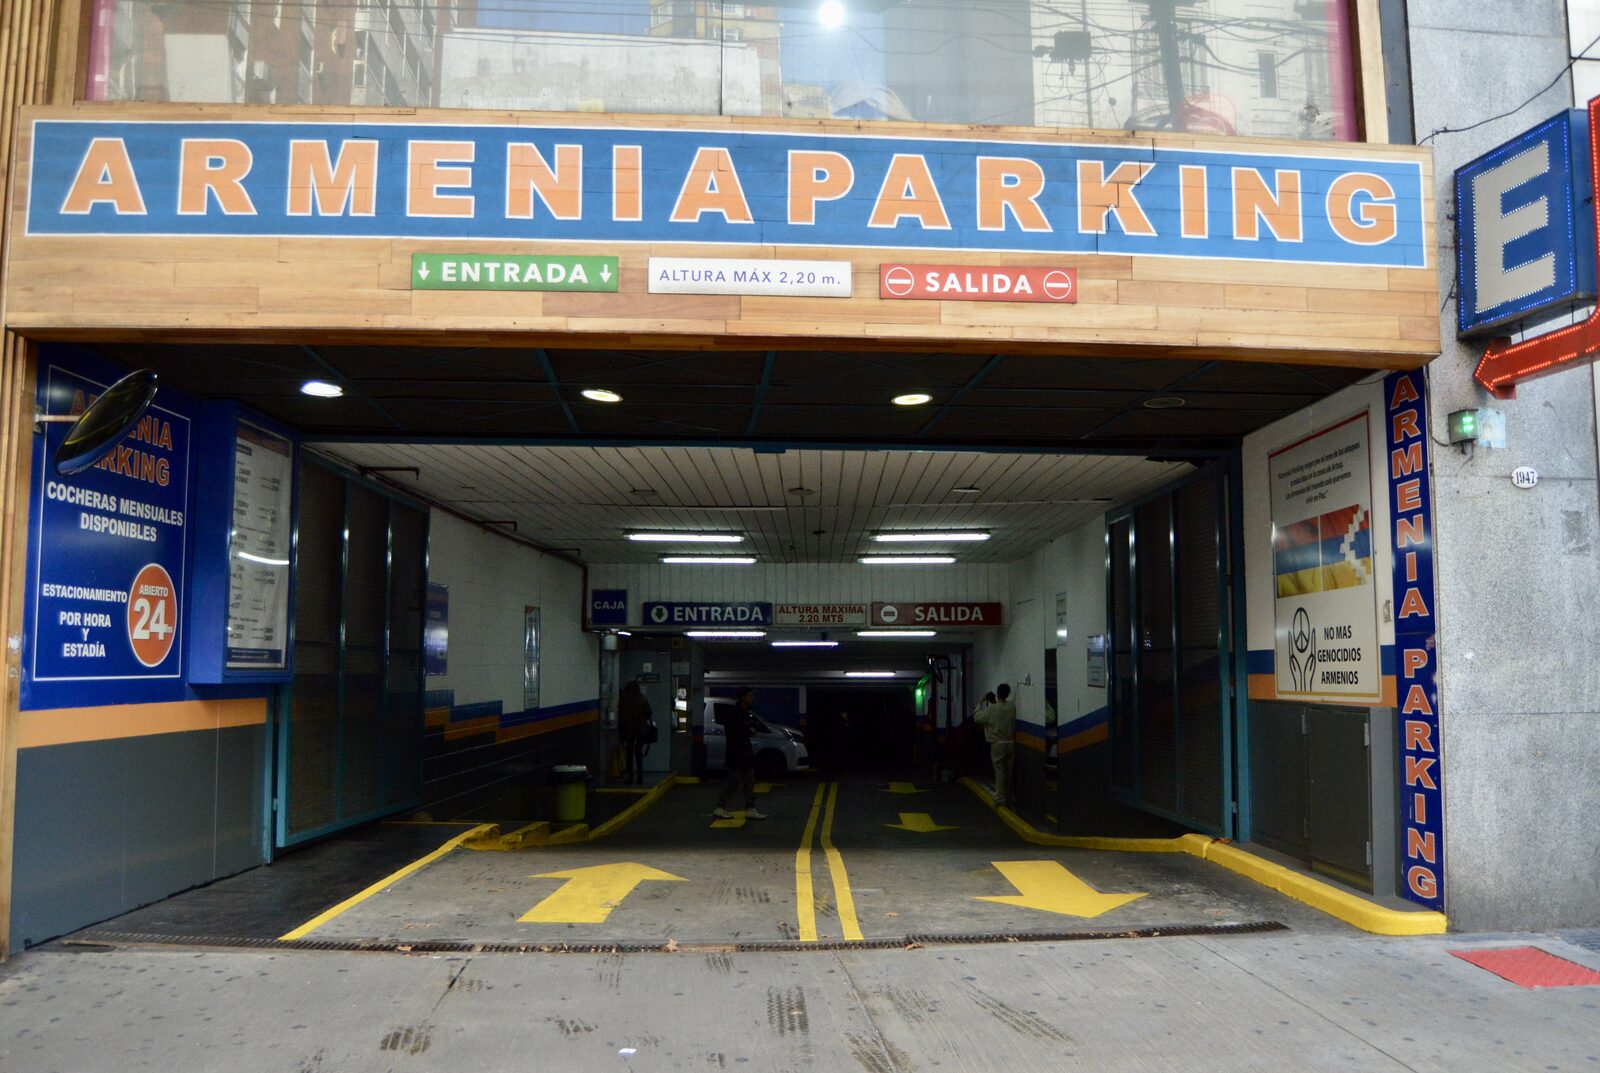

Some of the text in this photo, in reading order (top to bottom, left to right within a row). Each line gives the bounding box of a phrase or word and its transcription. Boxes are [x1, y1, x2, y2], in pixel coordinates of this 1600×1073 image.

[1471, 140, 1557, 314] E
[441, 261, 588, 284] ENTRADA
[659, 269, 841, 285] ALTURA MÁX 2,20 m.
[925, 272, 1033, 294] SALIDA
[1515, 471, 1535, 485] 1947
[47, 481, 184, 527] COCHERAS MENSUALES
[80, 512, 157, 543] DISPONIBLES
[43, 583, 128, 603] ESTACIONAMIENTO
[139, 585, 168, 597] ABIERTO
[594, 601, 625, 610] CAJA
[779, 605, 864, 614] ALTURA MAXIMA
[59, 611, 112, 628] POR HORA
[673, 606, 763, 622] ENTRADA
[799, 614, 844, 623] 2.20 MTS
[915, 606, 983, 622] SALIDA
[82, 628, 90, 641] Y
[1324, 625, 1352, 641] NO MAS
[1391, 375, 1440, 899] ARMENIA PARKING
[63, 641, 106, 657] ESTADÍA
[1317, 647, 1362, 663] GENOCIDIOS
[1321, 670, 1359, 685] ARMENIOS
